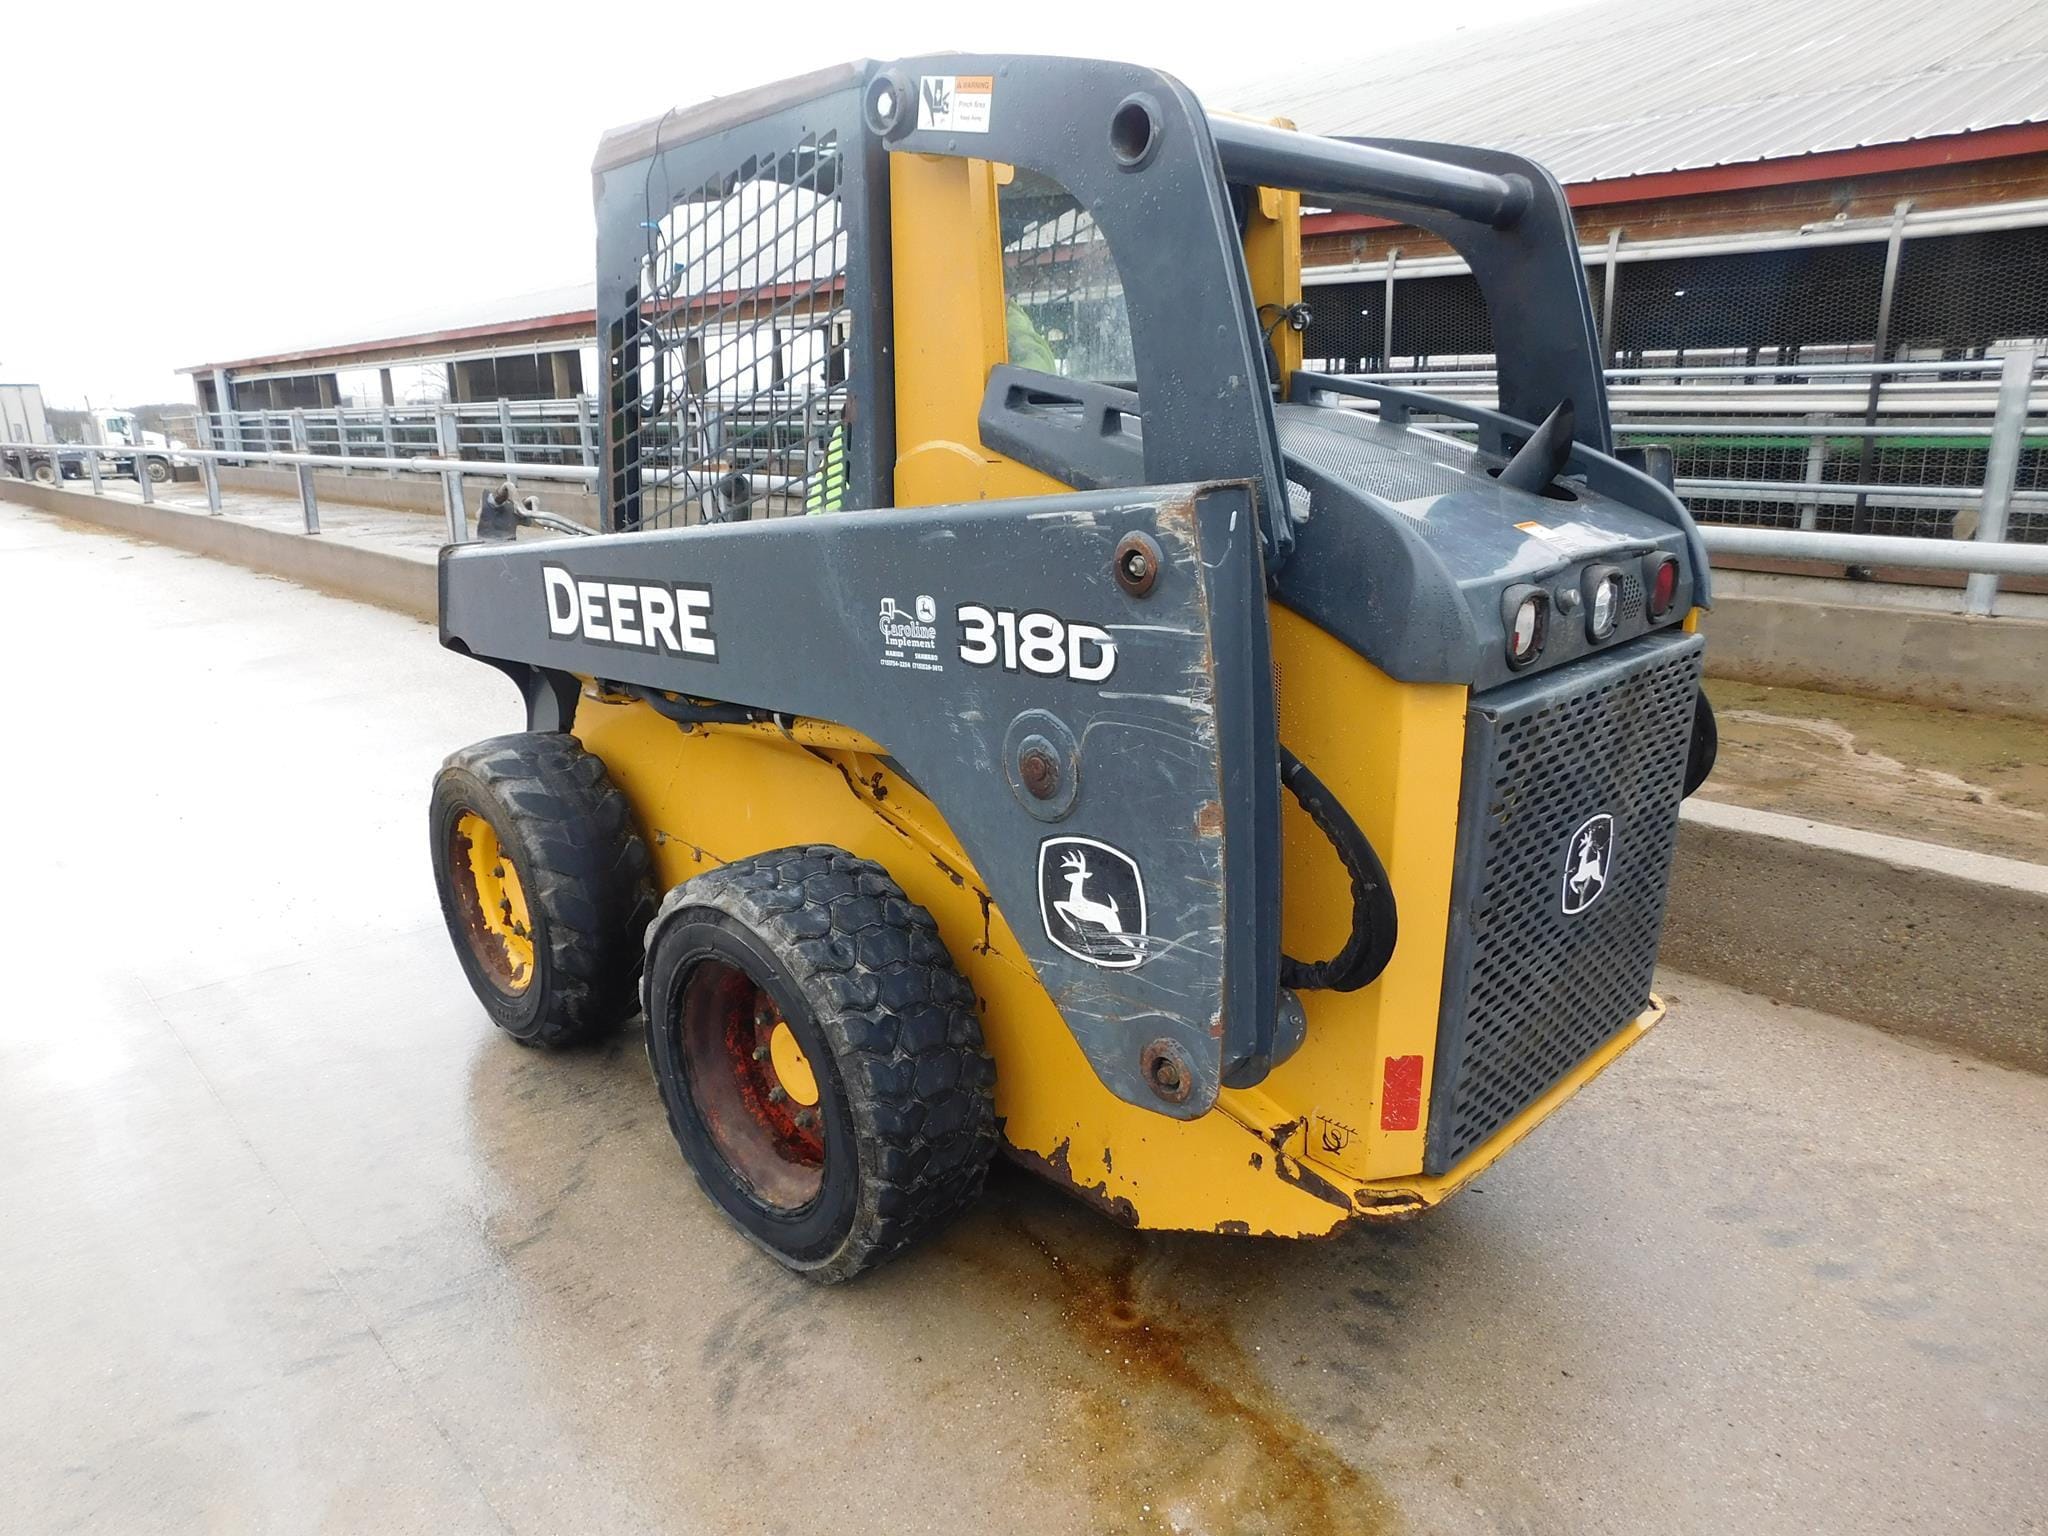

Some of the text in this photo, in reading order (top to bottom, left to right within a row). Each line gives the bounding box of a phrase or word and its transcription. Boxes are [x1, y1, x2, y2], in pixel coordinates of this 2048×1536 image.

[542, 566, 716, 656] DEERE
[885, 634, 935, 648] Implement
[957, 604, 1119, 682] 318D
